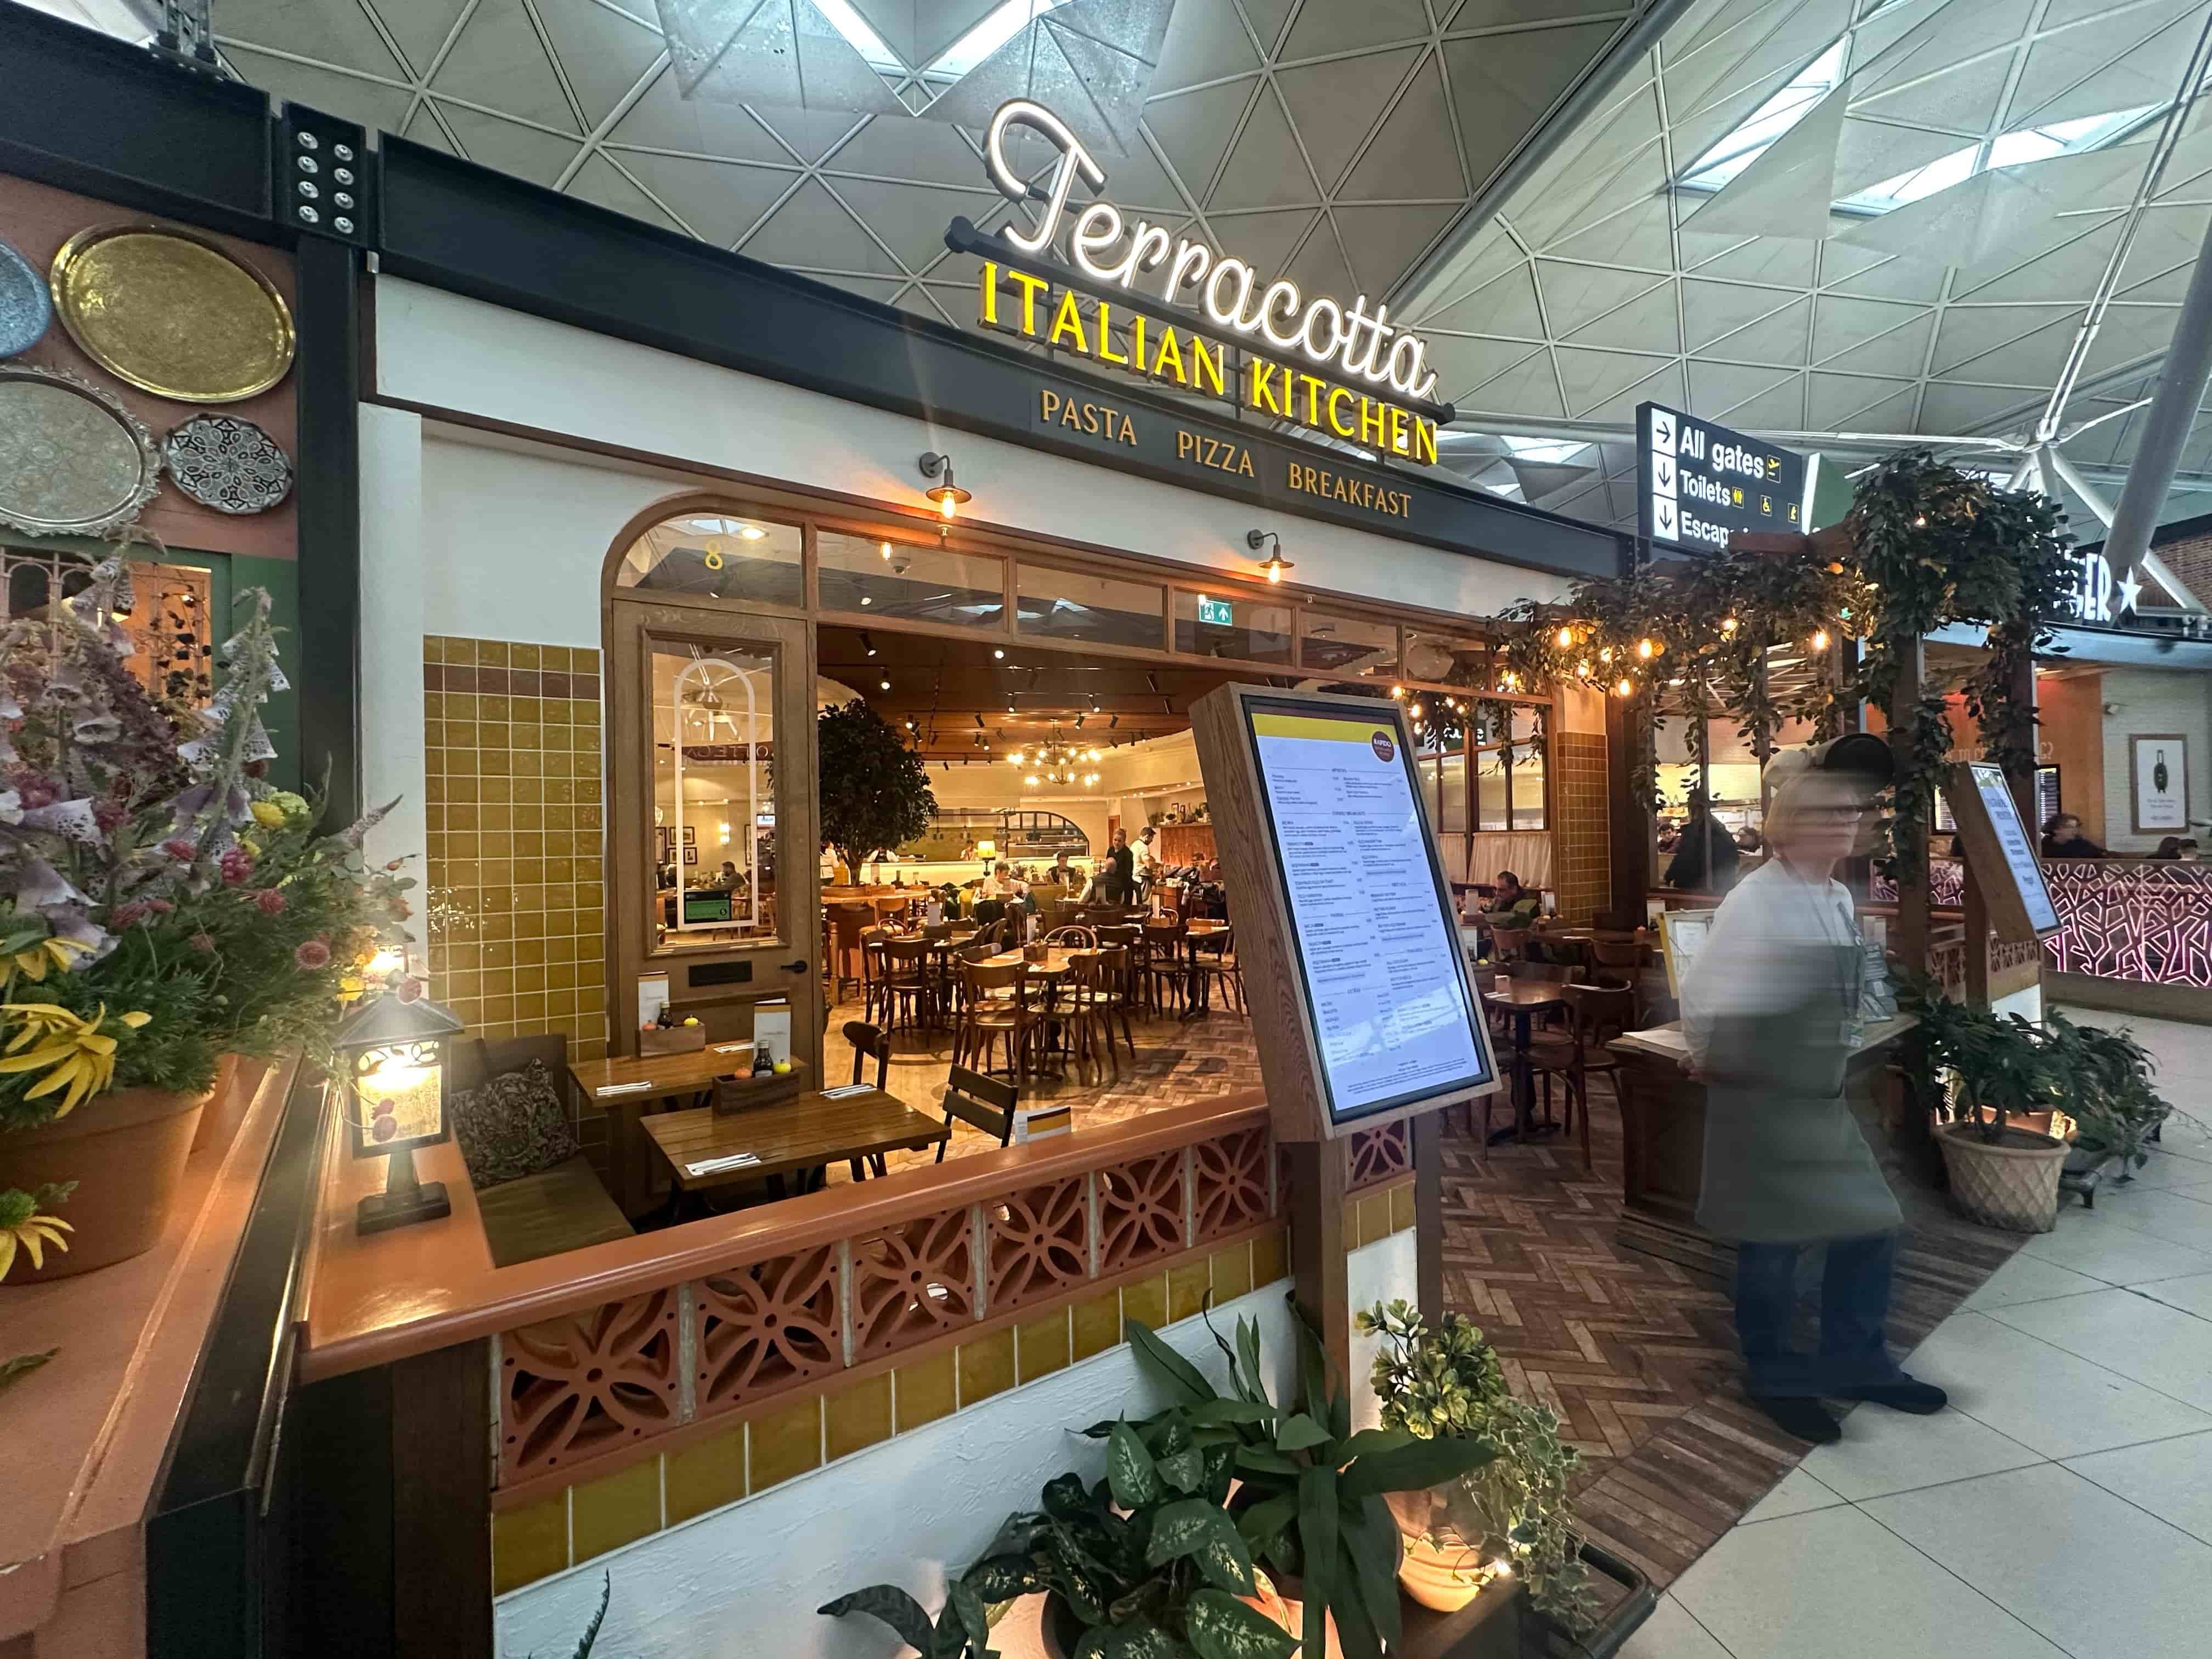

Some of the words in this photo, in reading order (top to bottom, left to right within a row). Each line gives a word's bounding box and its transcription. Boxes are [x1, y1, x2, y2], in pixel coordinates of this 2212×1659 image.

[986, 99, 1438, 397] Terracotta
[982, 262, 1225, 396] ITALIAN
[1251, 357, 1438, 465] KITCHEN
[1041, 390, 1137, 446] PASTA
[1177, 431, 1255, 478] PIZZA
[1288, 462, 1412, 518] BREAKFAST
[1679, 469, 1731, 506] Toilets
[1680, 426, 1705, 460] All
[1712, 443, 1764, 479] gates
[1680, 510, 1734, 548] Escap
